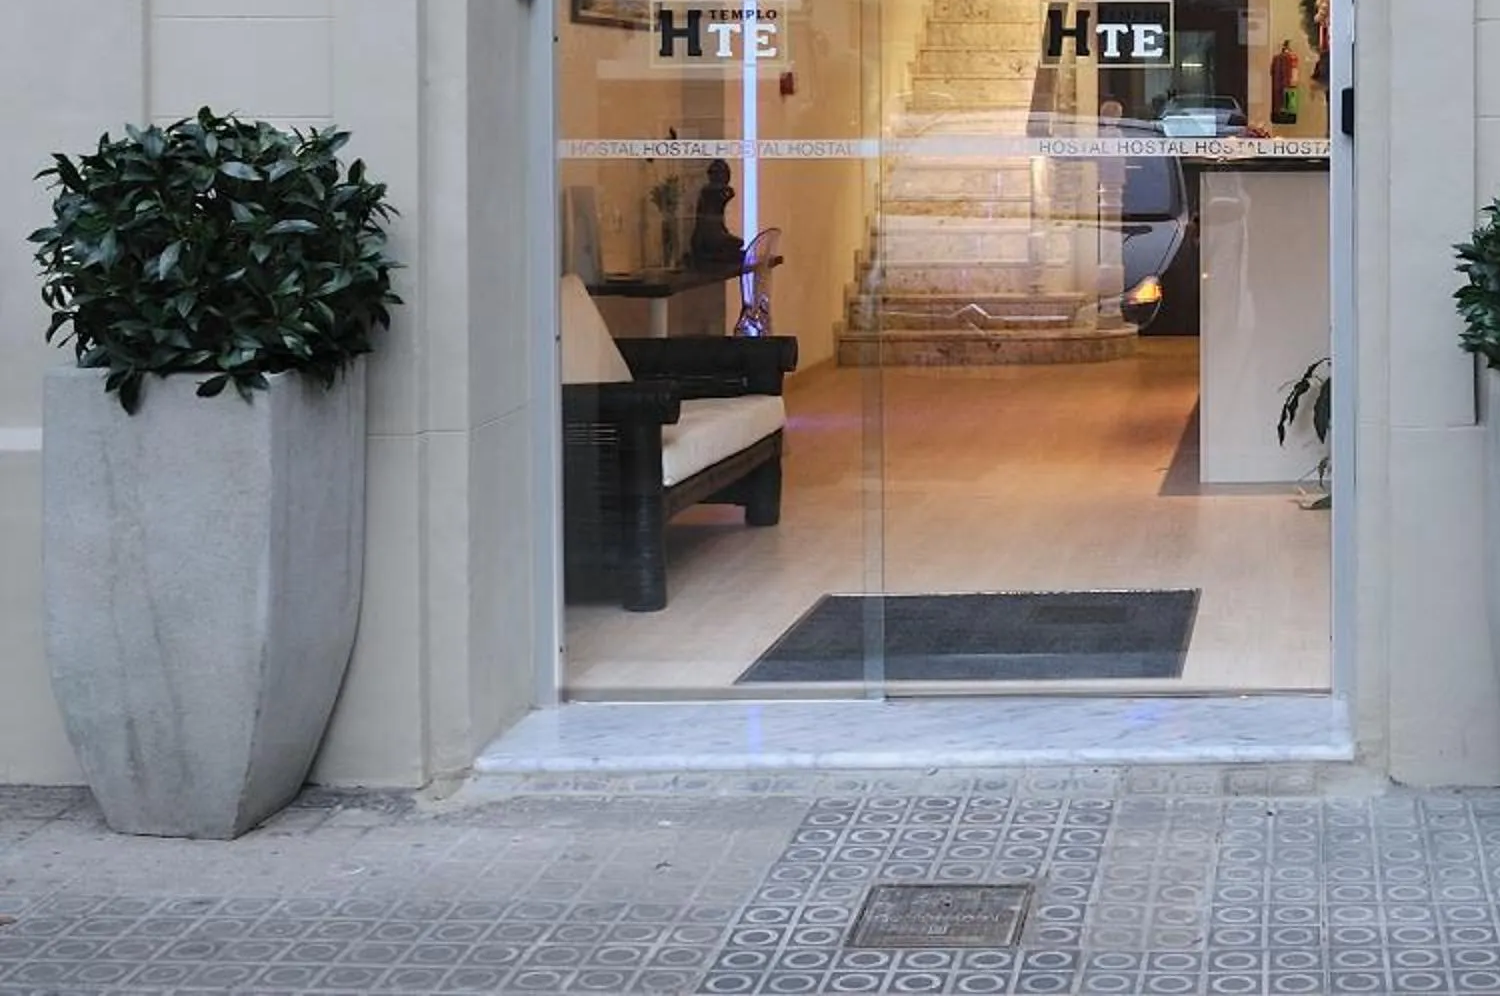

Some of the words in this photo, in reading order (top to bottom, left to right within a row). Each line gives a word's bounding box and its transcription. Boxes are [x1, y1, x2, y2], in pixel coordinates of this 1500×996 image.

[708, 10, 777, 20] TEMPLO
[643, 142, 712, 156] HOSTAL
[1039, 140, 1110, 154] HOSTAL
[1117, 140, 1189, 154] HOSTAL
